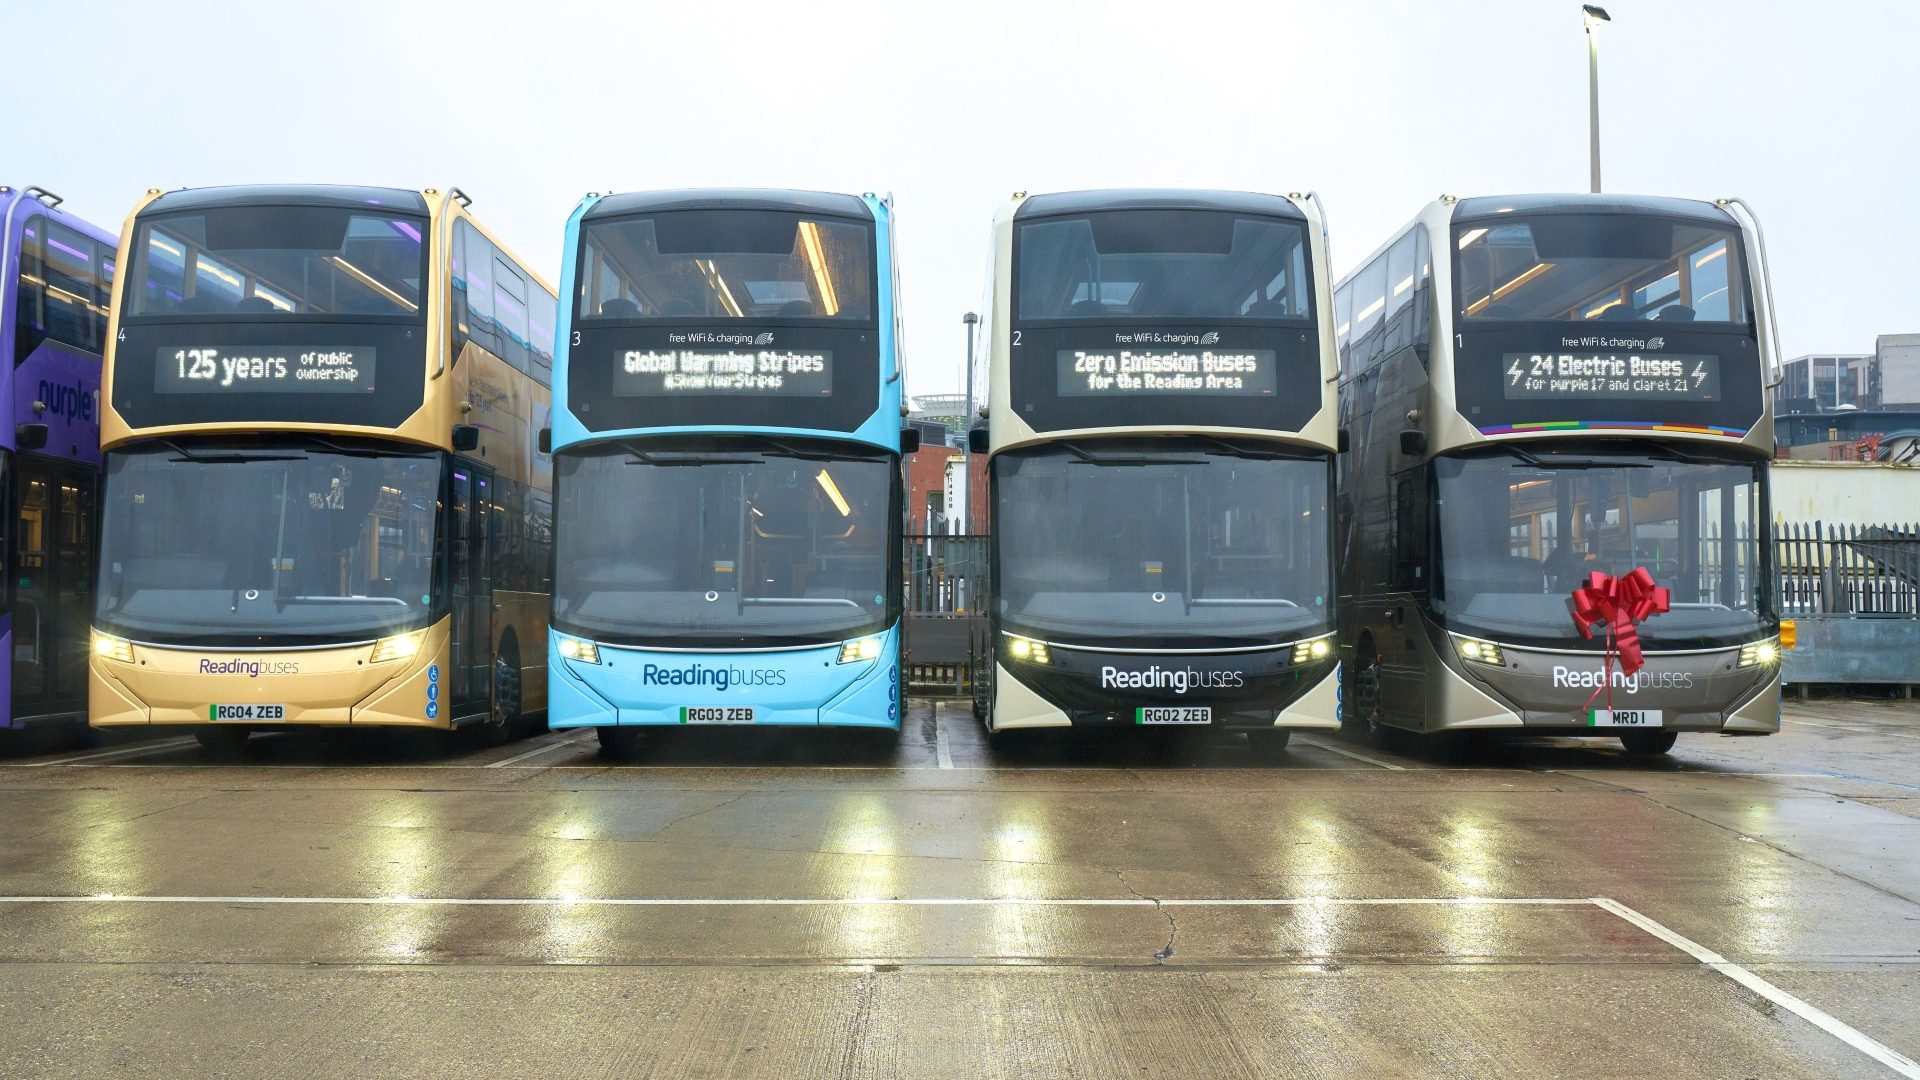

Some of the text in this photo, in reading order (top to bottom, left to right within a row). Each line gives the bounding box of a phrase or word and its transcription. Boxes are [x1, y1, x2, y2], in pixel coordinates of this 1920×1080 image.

[118, 328, 126, 341] 4
[572, 331, 581, 346] 3
[669, 333, 753, 345] free WiFi & charging
[1012, 331, 1022, 346] 2
[1115, 332, 1199, 345] free WiFi & charging
[1456, 333, 1463, 348] 1
[1562, 337, 1645, 349] free WiFi & charging
[301, 351, 353, 366] of public
[624, 351, 824, 374] Global Warming Stripes
[1074, 351, 1256, 373] Zero Emission Buses
[1530, 355, 1682, 377] 24 Electric Buses
[175, 349, 288, 386] 125 years
[296, 367, 358, 382] ownership
[1087, 373, 1242, 390] for the Reading Area
[1525, 377, 1688, 392] for purple 17 and claret 21
[38, 380, 91, 425] purple
[199, 658, 299, 677] Readingbuses
[643, 664, 786, 691] Readingbuses
[1102, 666, 1243, 693] Readingbuses
[1553, 666, 1693, 694] Readngbuses
[218, 706, 283, 718] RG04 ZEB
[688, 709, 753, 721] RG03 ZEB
[1144, 709, 1209, 721] RG02 ZEB
[1613, 712, 1638, 724] MRD
